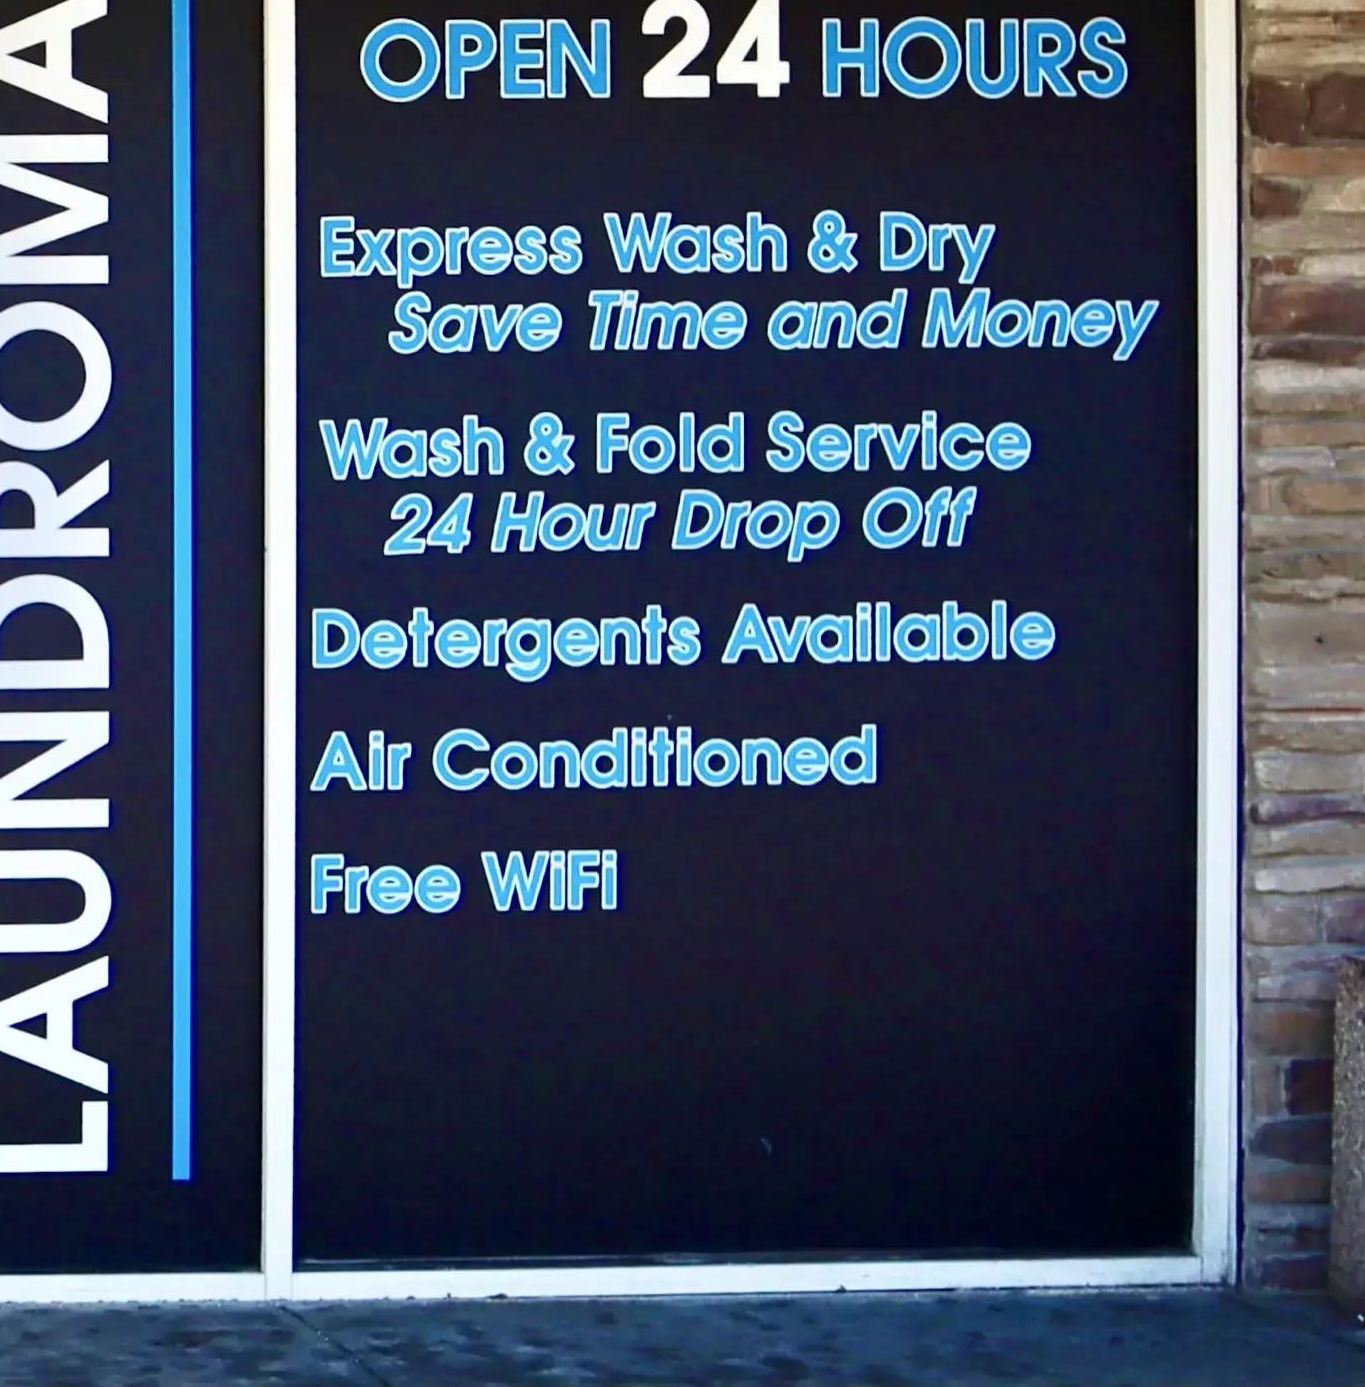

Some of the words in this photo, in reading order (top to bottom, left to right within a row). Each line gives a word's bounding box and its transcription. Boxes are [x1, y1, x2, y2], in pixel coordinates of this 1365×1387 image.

[359, 18, 611, 103] OPEN
[821, 15, 1129, 100] HOURS
[319, 215, 583, 287] Express
[602, 211, 788, 274] Wash
[807, 210, 859, 274] &
[879, 211, 996, 283] Dry
[387, 291, 563, 355] Save
[587, 290, 748, 351] Time
[767, 288, 909, 351] and
[921, 288, 1160, 362] Money
[319, 414, 505, 481] Wash
[523, 411, 576, 477] &
[596, 411, 745, 475] Fold
[765, 409, 1032, 473] Service
[383, 492, 474, 556] 24
[490, 490, 657, 553] Hour
[671, 488, 841, 563] Drop
[861, 485, 978, 550] Off
[311, 604, 702, 683] Detergents
[720, 599, 1057, 664] Available
[309, 729, 413, 792] Air
[431, 723, 878, 791] Conditioned
[310, 853, 462, 915] Free
[480, 849, 618, 912] WiFi
